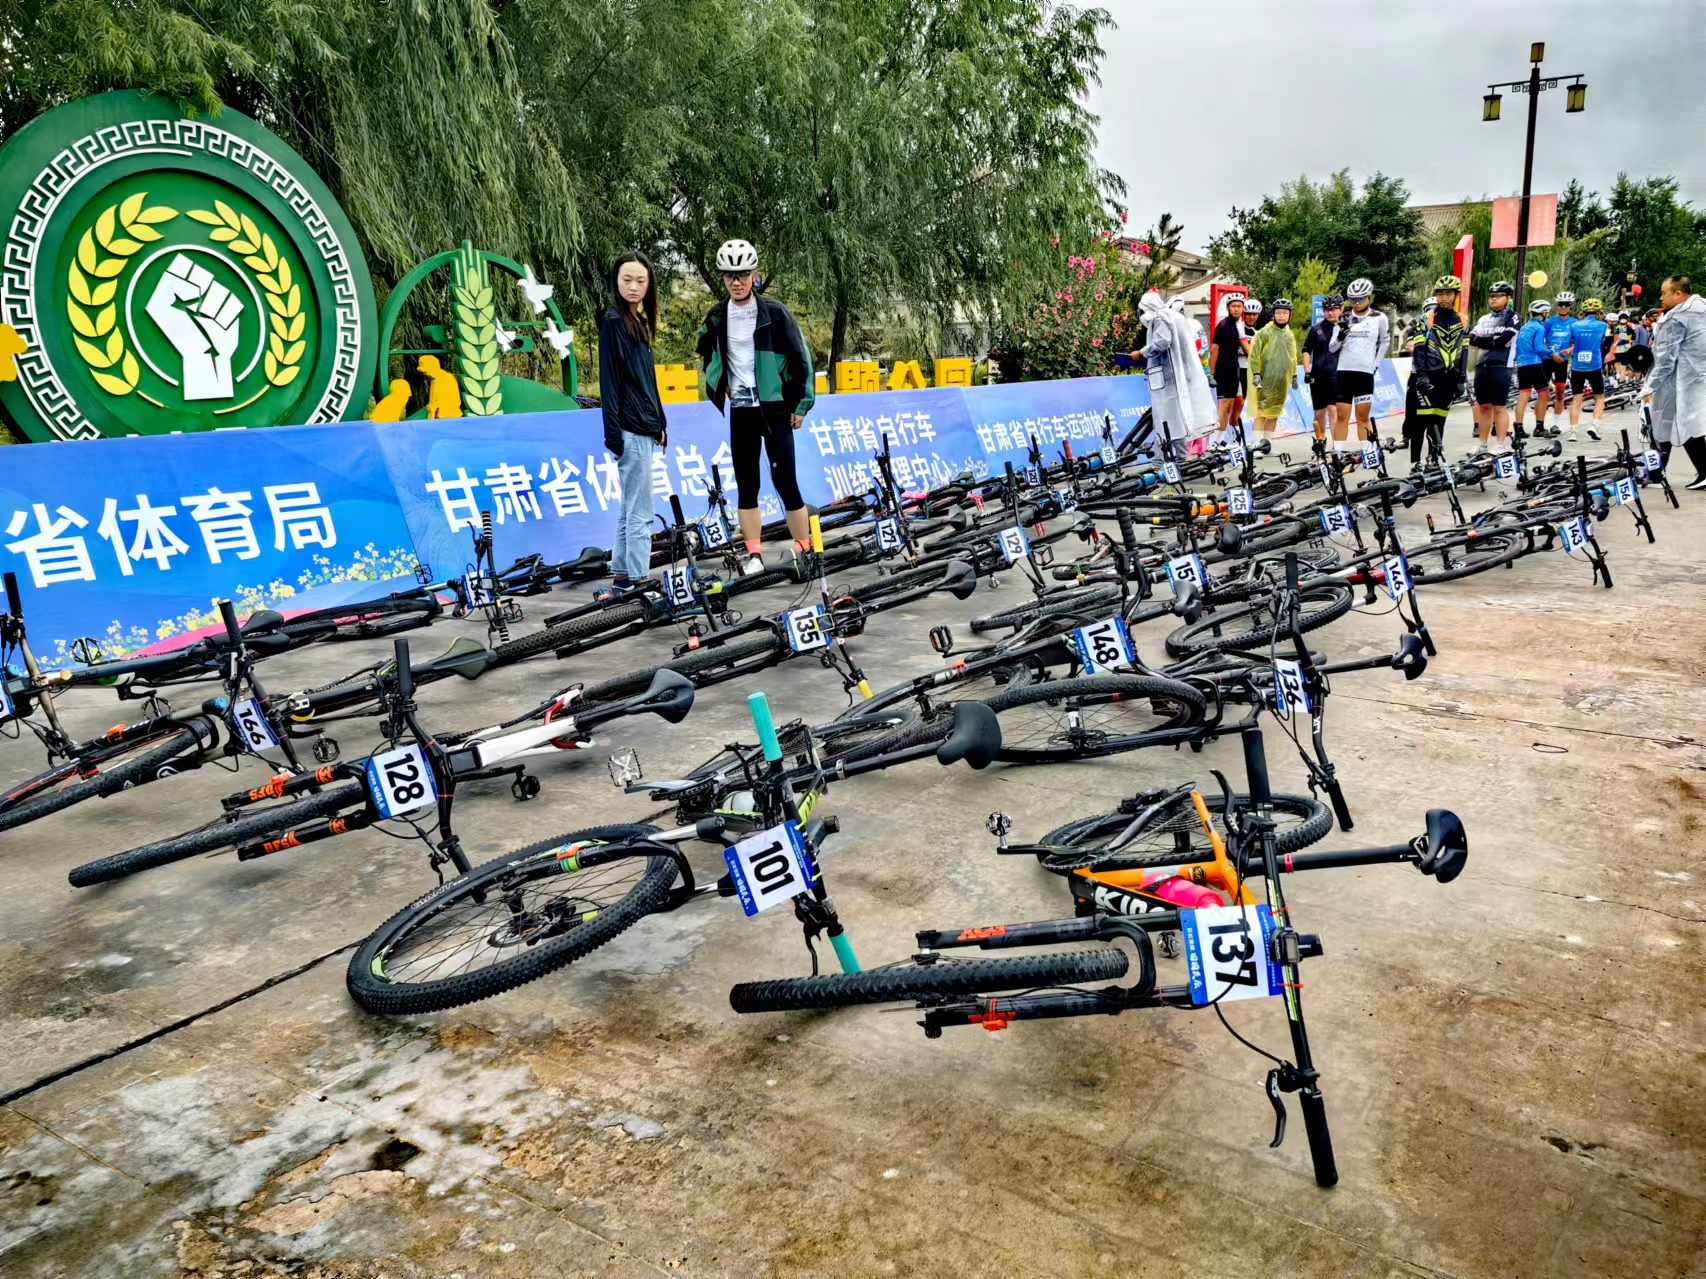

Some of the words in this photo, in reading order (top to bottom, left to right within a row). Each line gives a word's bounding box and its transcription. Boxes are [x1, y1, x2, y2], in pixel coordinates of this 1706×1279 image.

[808, 410, 937, 457] 甘肃省自行车
[976, 408, 1120, 454] 甘肃省自行车运动协会
[1103, 450, 1114, 462] 105
[1234, 450, 1242, 464] 152
[1367, 451, 1378, 465] 138
[1501, 459, 1513, 474] 126
[1647, 454, 1658, 467] 161
[823, 451, 949, 501] 训练管理中心
[1028, 468, 1037, 484] 120
[1165, 464, 1177, 480] 157
[1233, 491, 1246, 511] 125
[1619, 481, 1632, 501] 156
[706, 521, 723, 544] 133
[1326, 509, 1345, 532] 124
[0, 482, 338, 589] 省体育局
[881, 523, 897, 544] 127
[1005, 531, 1023, 555] 129
[1568, 523, 1583, 546] 143
[670, 570, 688, 600] 130
[1388, 561, 1402, 592] 146
[795, 610, 821, 645] 135
[1088, 623, 1120, 666] 148
[1281, 666, 1303, 706] 136
[237, 707, 267, 746] 166
[383, 752, 426, 806] 128
[749, 840, 795, 896] 101
[1208, 918, 1259, 988] 137
